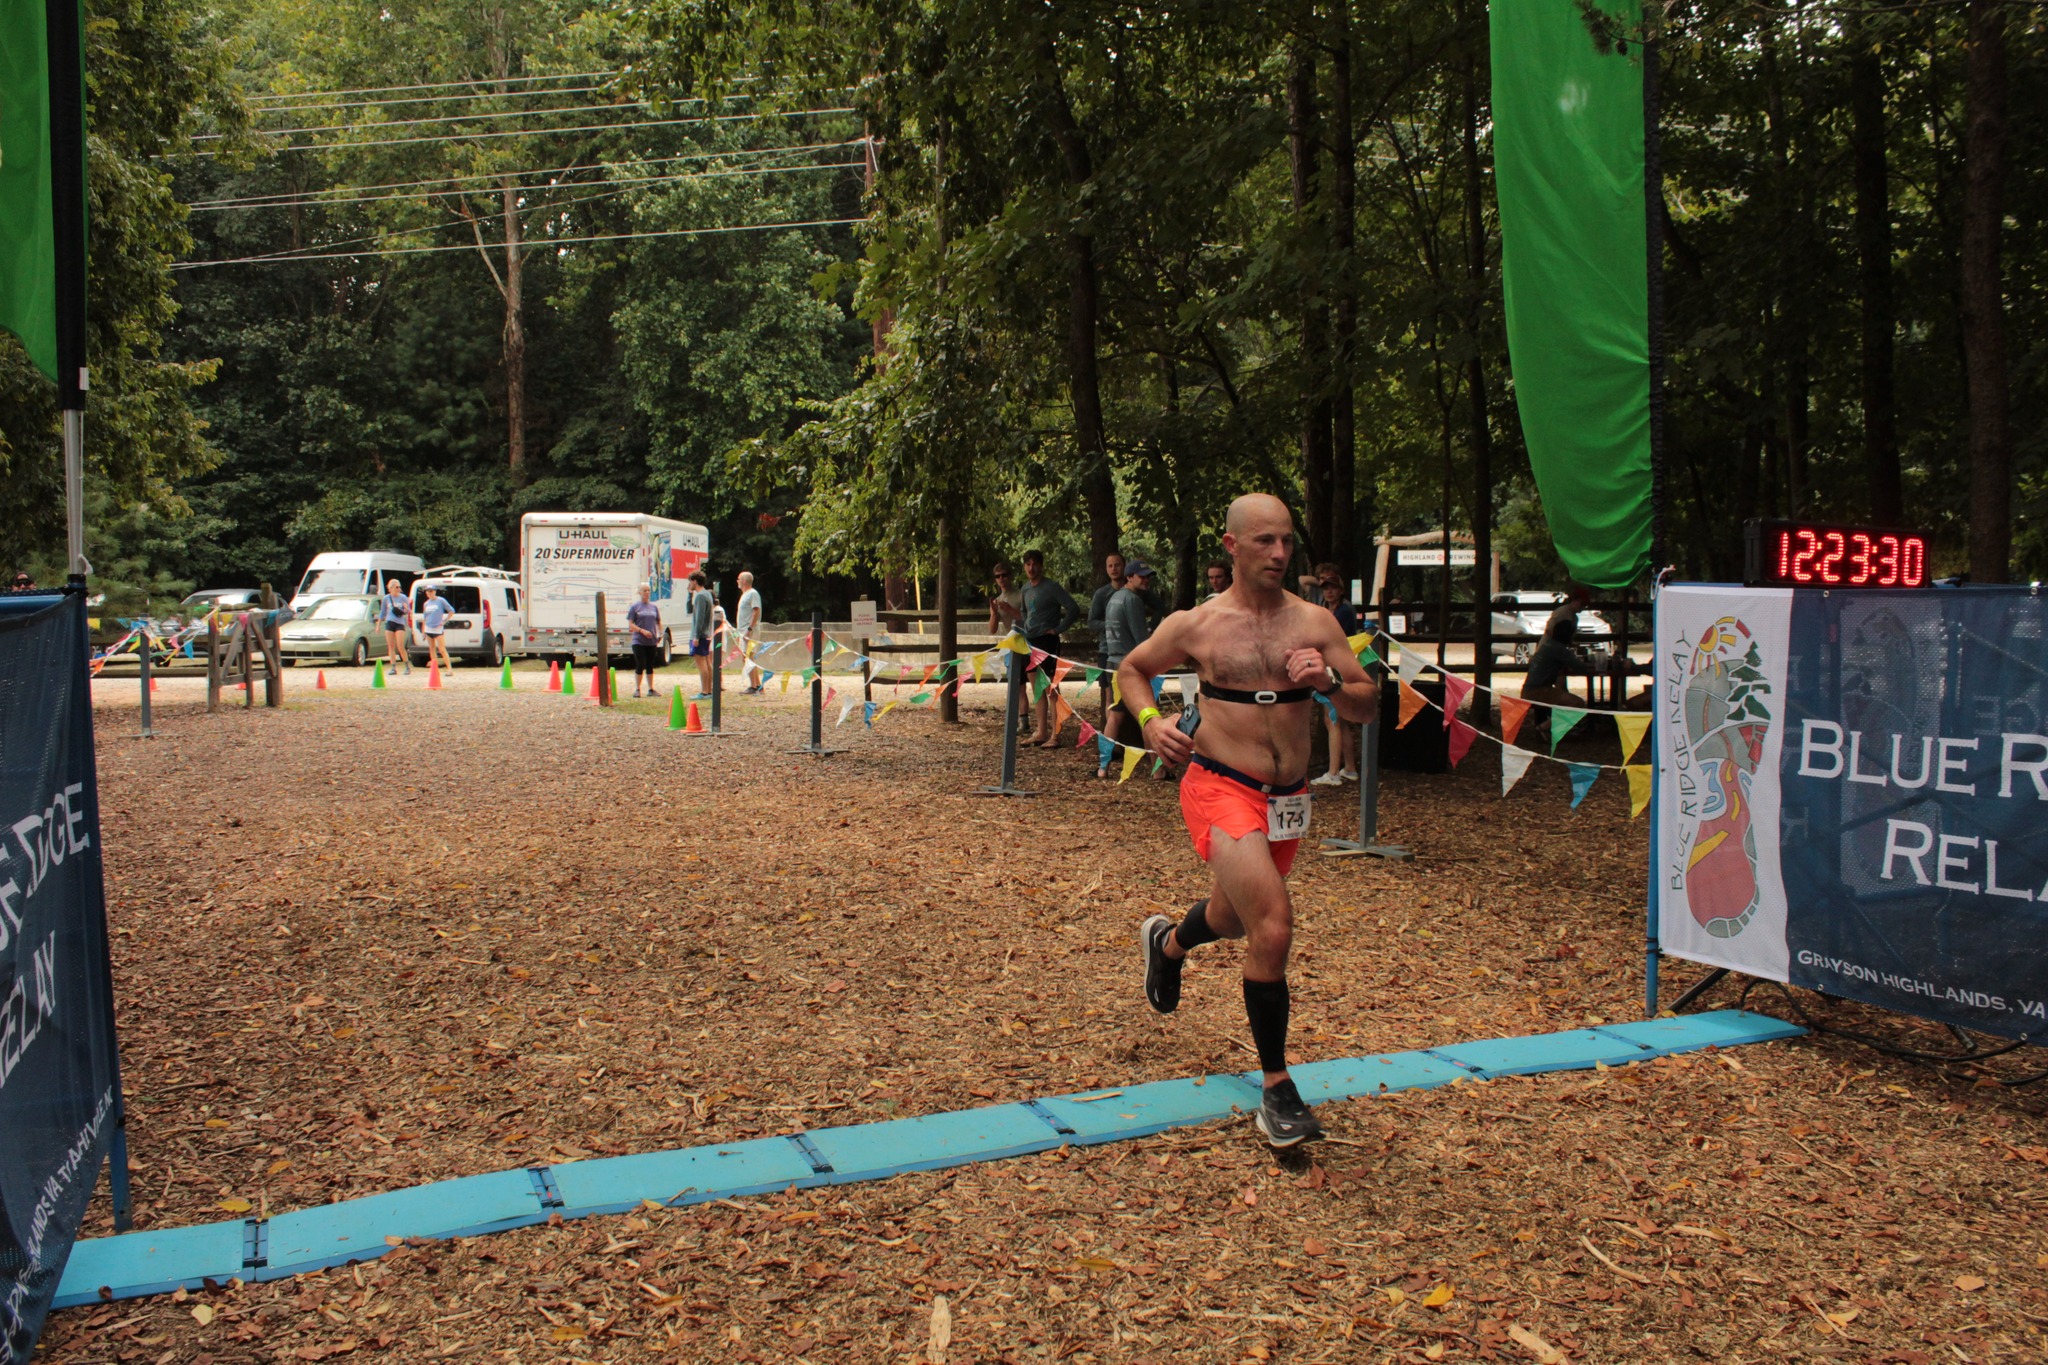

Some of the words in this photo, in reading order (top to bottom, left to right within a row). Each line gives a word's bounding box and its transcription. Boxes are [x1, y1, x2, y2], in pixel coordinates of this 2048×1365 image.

[553, 547, 635, 560] SUPERMOVER
[559, 530, 608, 539] U-HAUL
[1778, 530, 1924, 586] 12:23:30
[1673, 733, 1697, 818] RIDGE
[1797, 718, 1979, 797] BLUE
[1671, 823, 1691, 890] BLUE
[1880, 817, 2048, 903] REL
[1797, 948, 1878, 985] GRAYSON
[1881, 971, 2014, 1014] HIGHLANDS,
[2016, 998, 2046, 1019] VA
